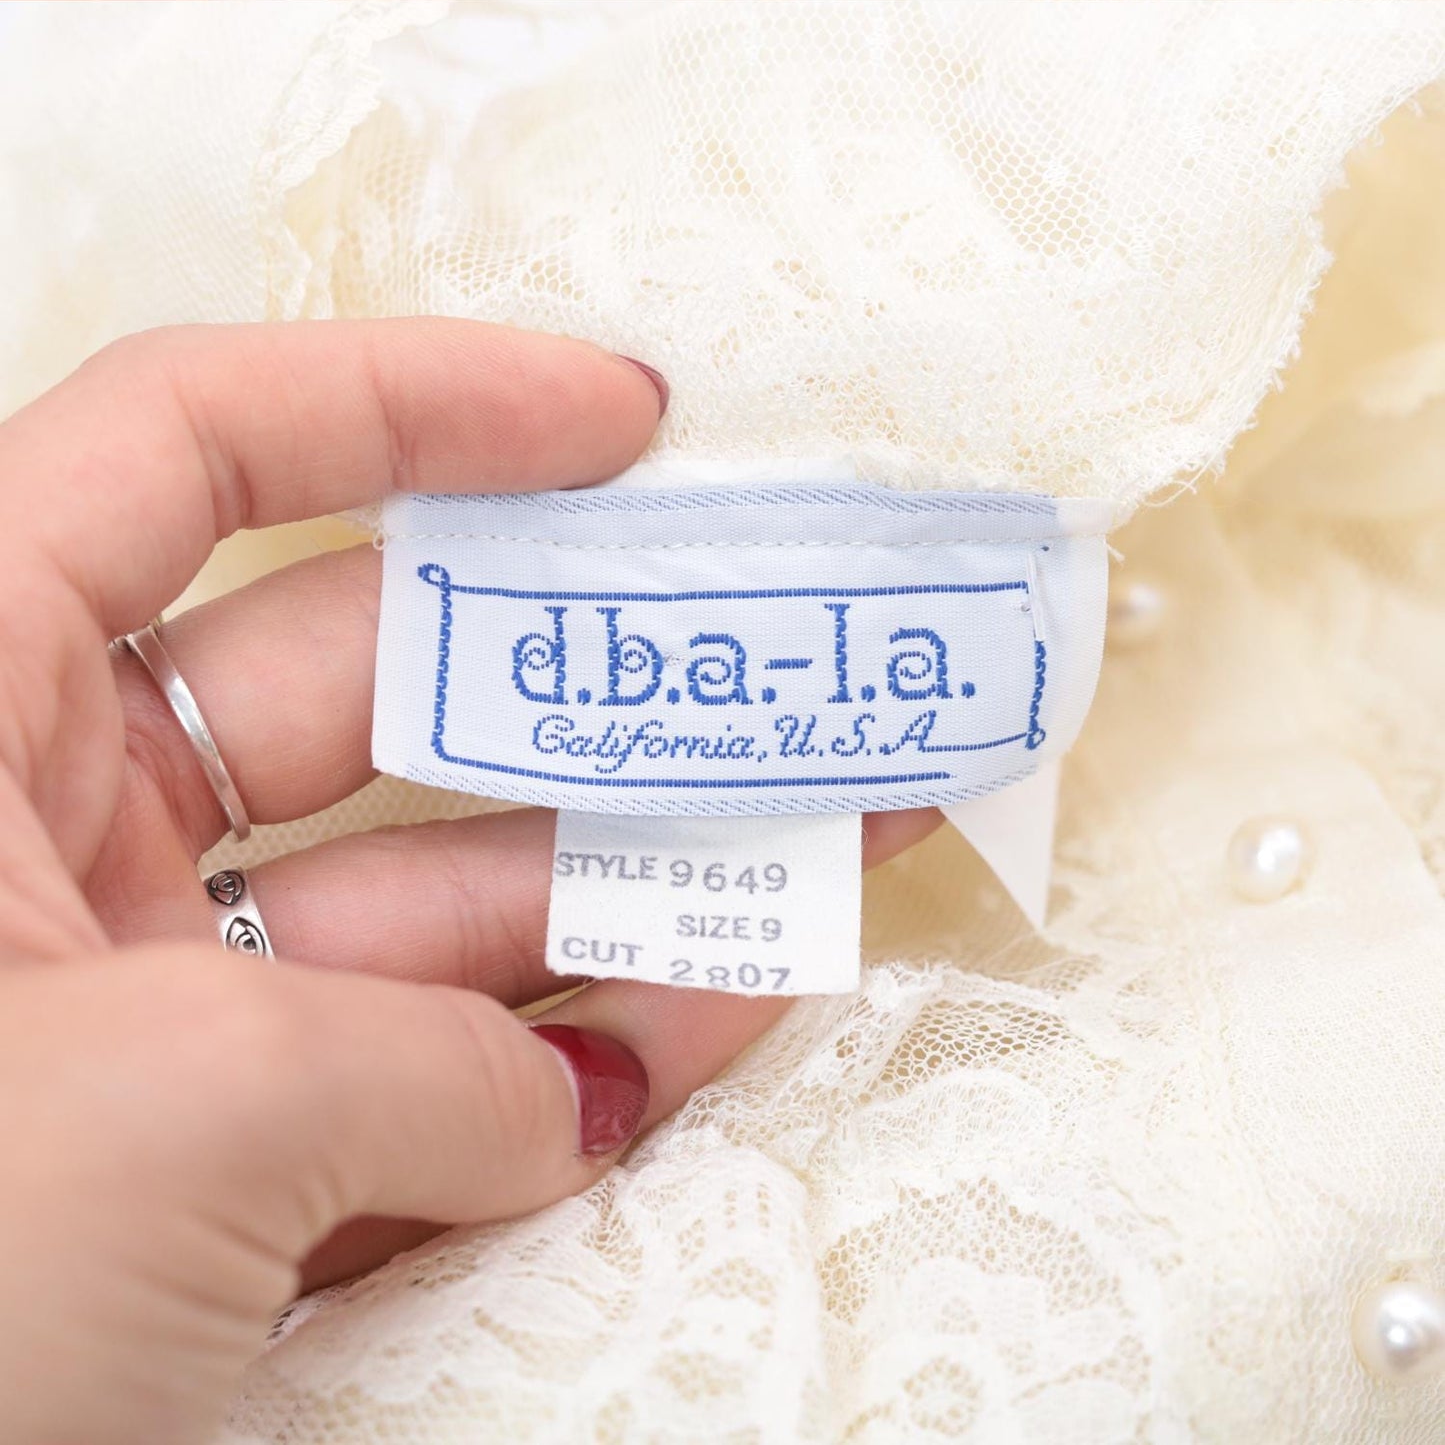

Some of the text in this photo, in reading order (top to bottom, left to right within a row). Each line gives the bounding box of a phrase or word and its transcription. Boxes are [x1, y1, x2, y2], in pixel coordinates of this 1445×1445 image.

[554, 851, 788, 894] STYLE 9649
[675, 913, 783, 943] SIZE 9
[560, 936, 792, 990] CUT 2807
